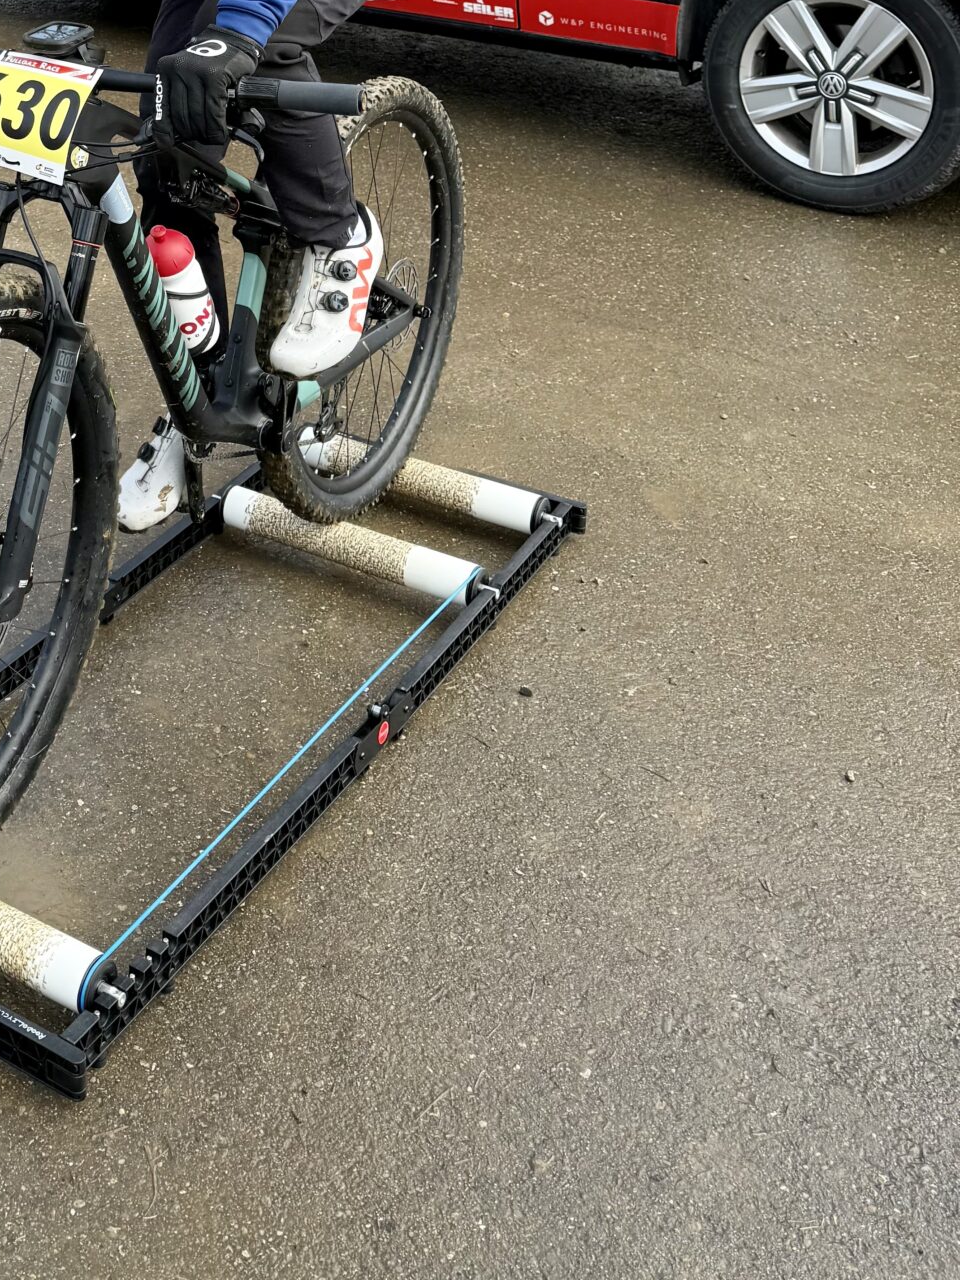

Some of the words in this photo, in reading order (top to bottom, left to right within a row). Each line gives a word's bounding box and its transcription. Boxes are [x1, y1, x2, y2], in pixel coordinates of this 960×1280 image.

[463, 1, 515, 19] SEILER
[590, 21, 668, 41] ENGINEERING
[155, 73, 163, 121] ERGON
